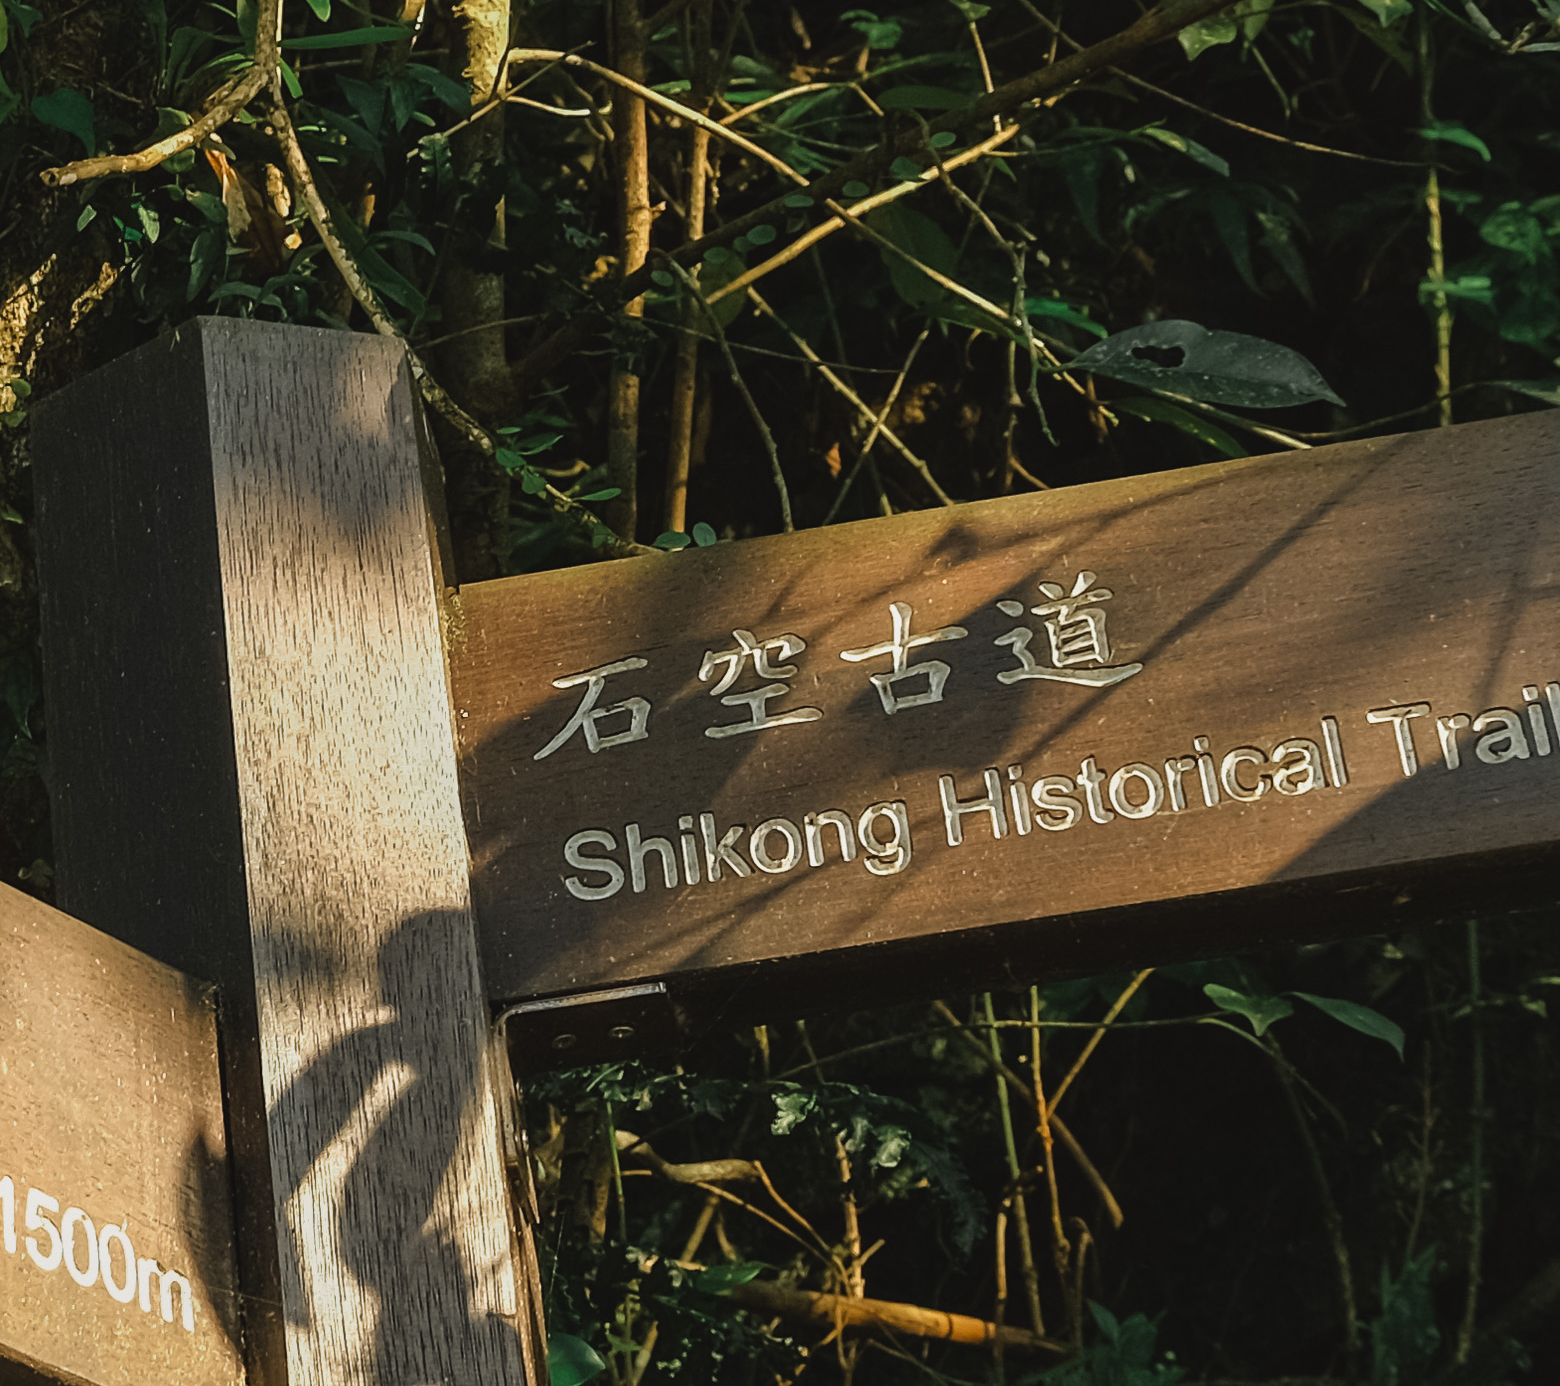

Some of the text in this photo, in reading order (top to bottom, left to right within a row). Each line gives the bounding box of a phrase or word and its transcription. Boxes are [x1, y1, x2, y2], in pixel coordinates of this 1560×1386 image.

[532, 570, 1144, 762] 石空古道
[562, 797, 913, 903] Shikong
[938, 715, 1346, 848] Historical
